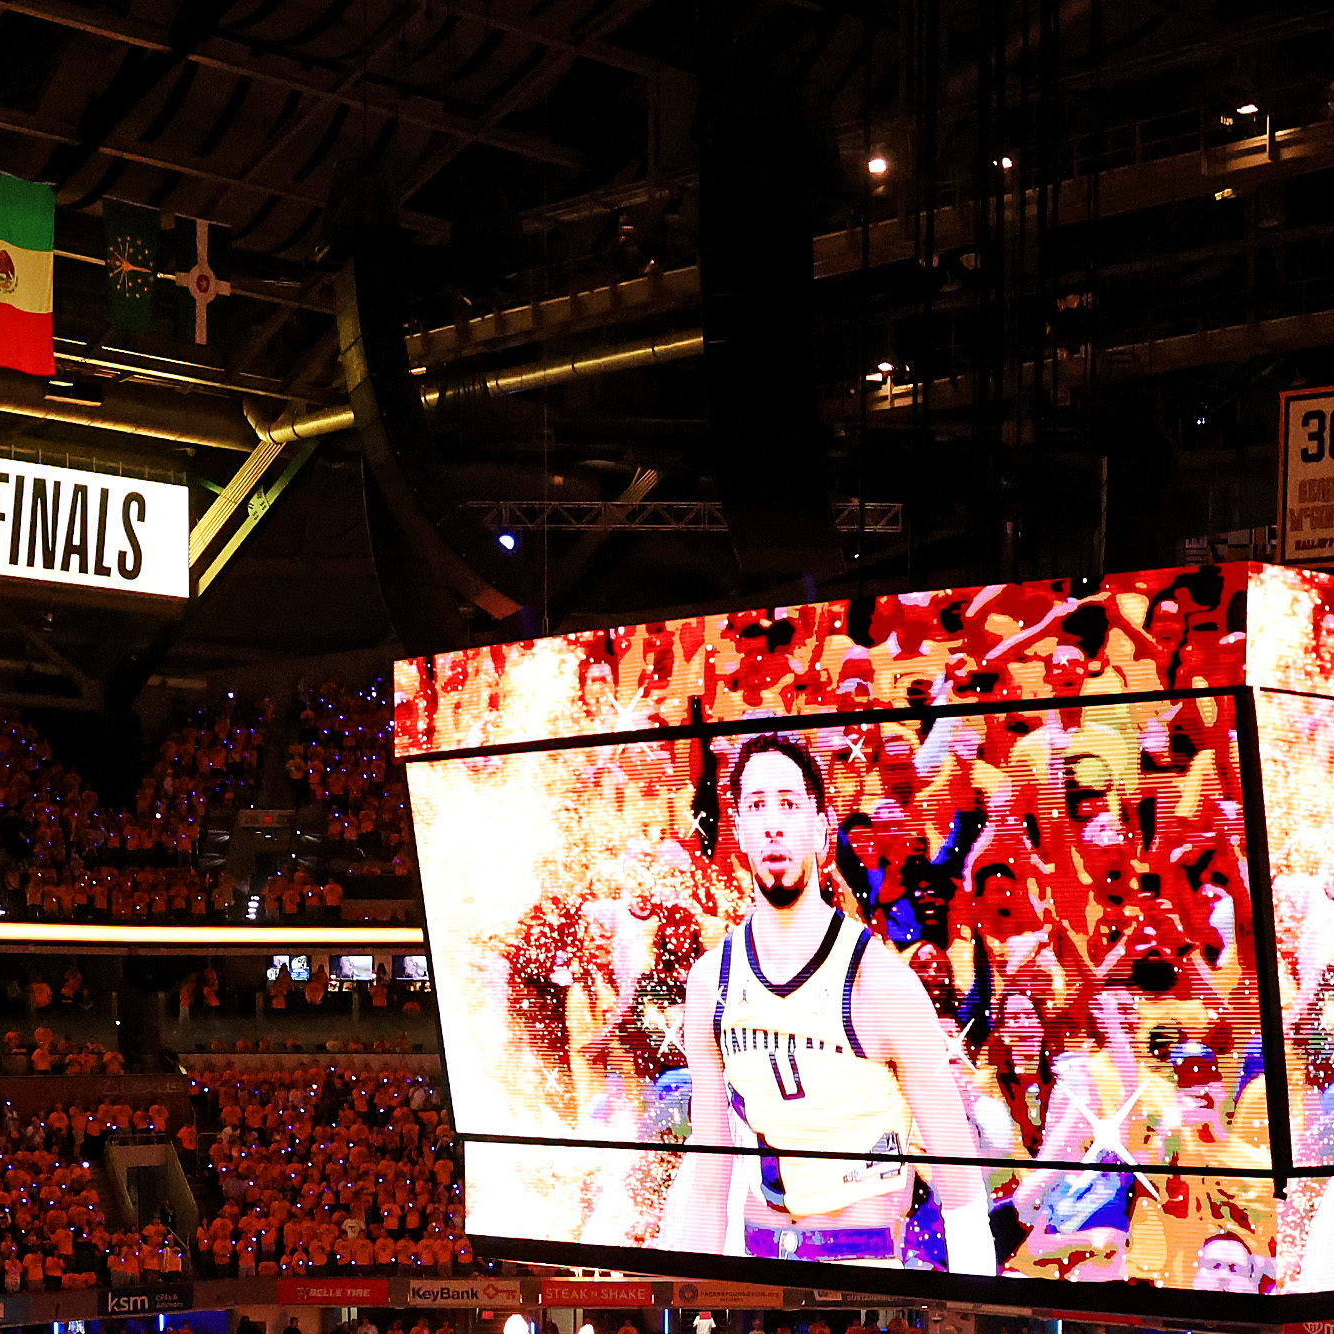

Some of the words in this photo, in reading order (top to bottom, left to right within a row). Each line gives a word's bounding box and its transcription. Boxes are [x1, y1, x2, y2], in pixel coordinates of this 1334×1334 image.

[411, 1286, 479, 1302] KeyBank
[544, 1287, 589, 1300] STEAK
[599, 1287, 646, 1300] SHAKE
[107, 1291, 149, 1313] ksm
